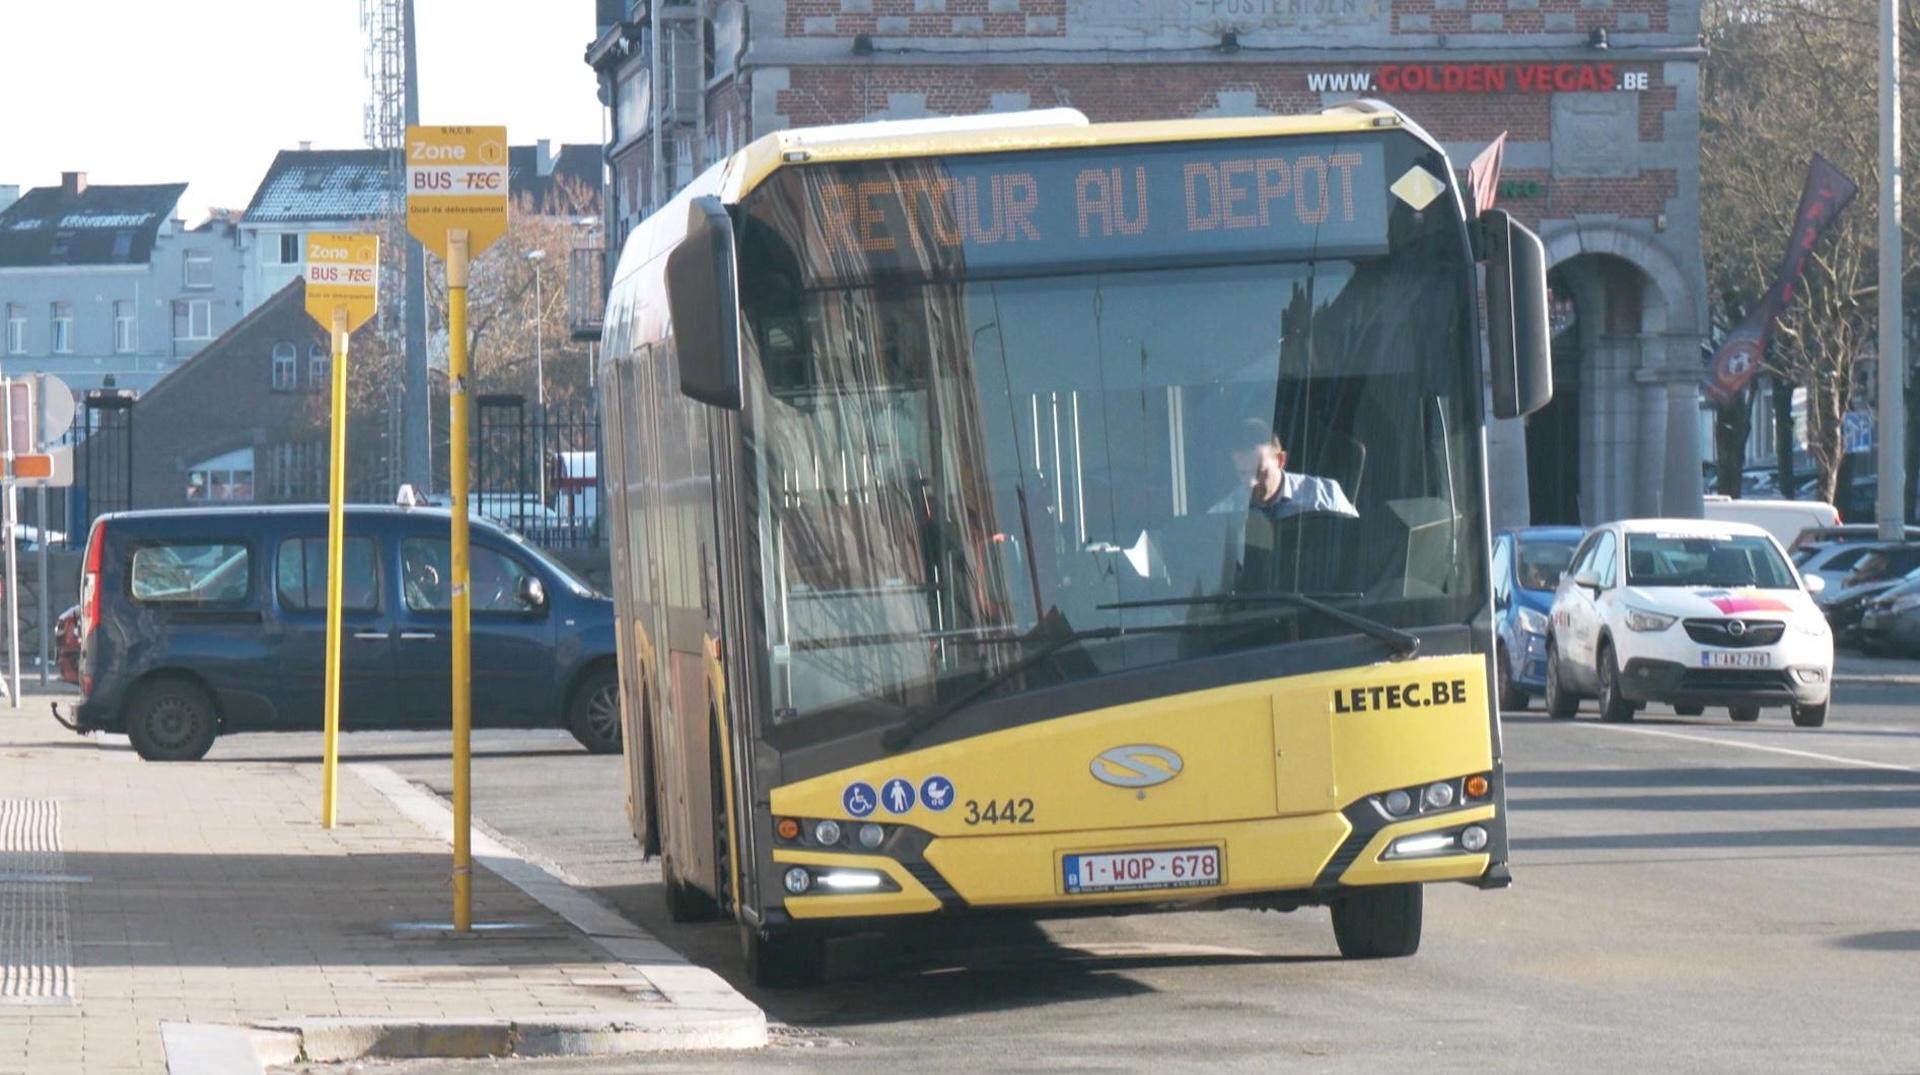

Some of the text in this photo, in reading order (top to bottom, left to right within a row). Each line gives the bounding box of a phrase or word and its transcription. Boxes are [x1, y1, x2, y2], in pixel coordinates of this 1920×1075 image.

[411, 140, 467, 160] Zone
[413, 171, 501, 190] BUS TEC
[820, 152, 1363, 253] RETOUR AU DEPOT
[309, 244, 349, 260] Zone
[310, 266, 372, 281] BUS TEC
[1334, 679, 1467, 714] LETEC.BE
[964, 798, 1035, 825] 3442
